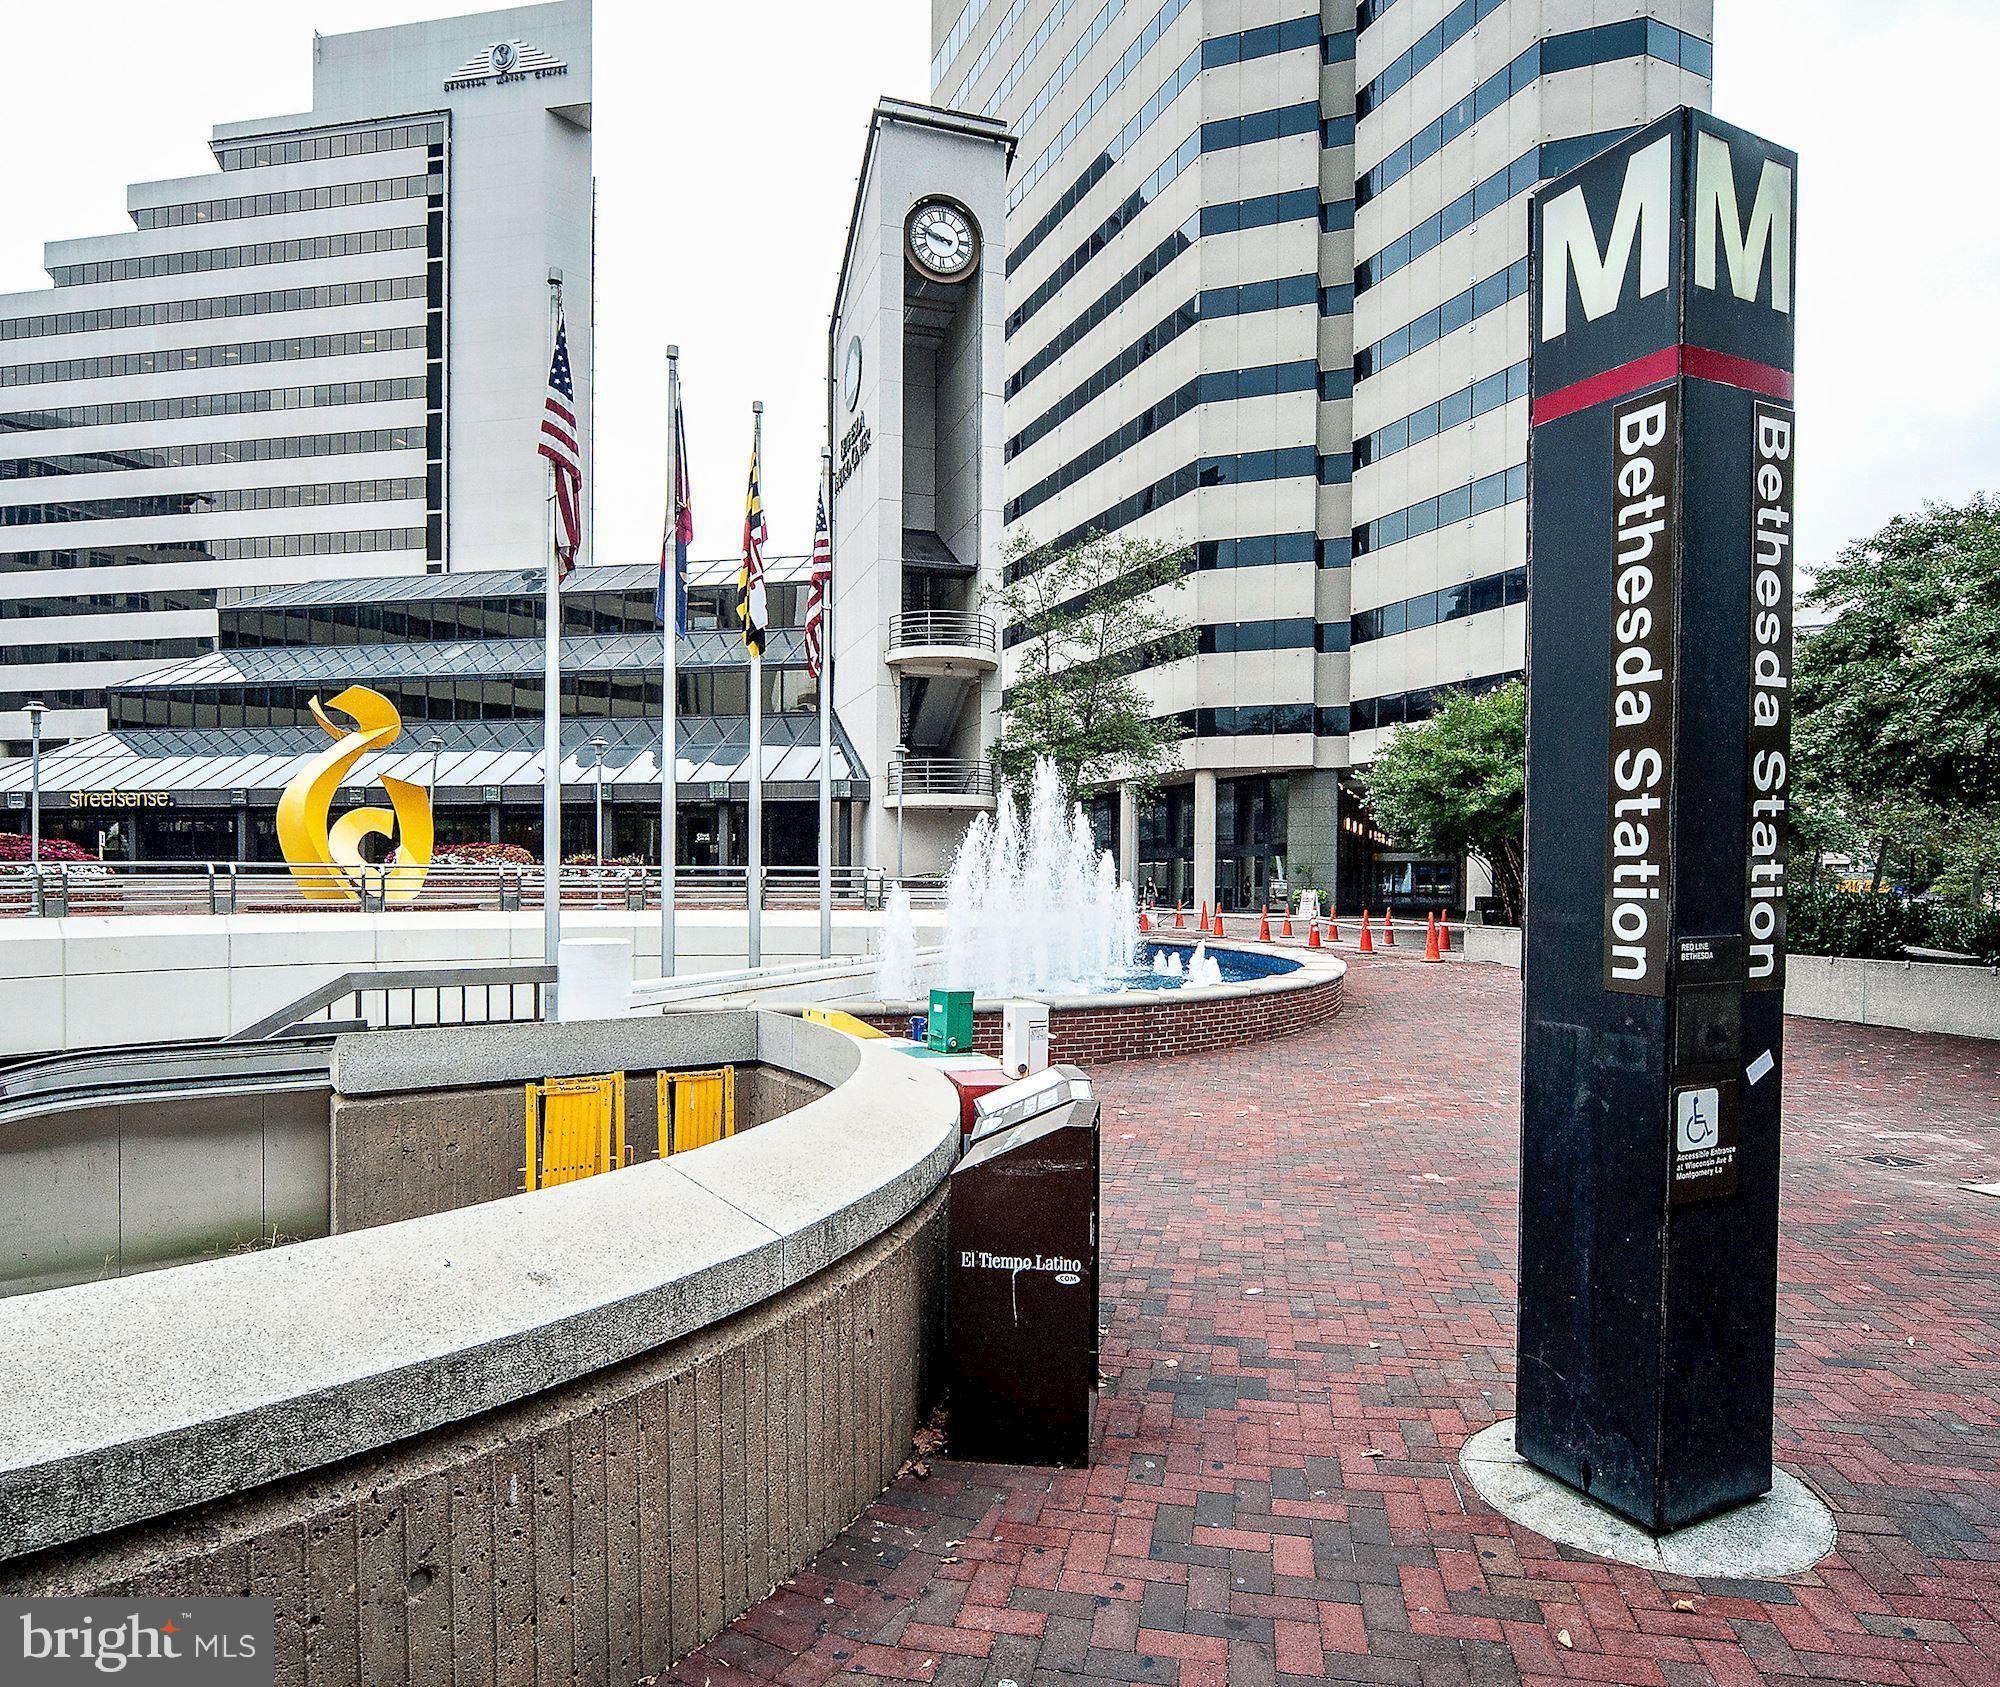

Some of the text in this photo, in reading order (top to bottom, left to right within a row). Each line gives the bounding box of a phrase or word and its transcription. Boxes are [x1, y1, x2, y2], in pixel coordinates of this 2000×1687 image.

[1694, 130, 1793, 315] M
[1542, 132, 1672, 343] M
[1611, 400, 1667, 981] Bethesda Station
[1749, 415, 1792, 978] Bethesda Station
[1681, 942, 1709, 952] RED LINE
[1681, 952, 1714, 961] BETHESDA
[1676, 1146, 1737, 1162] Accessible Entrance
[1676, 1163, 1684, 1171] at
[1684, 1158, 1715, 1170] Wisconsin
[1715, 1156, 1727, 1165] Ave
[1675, 1166, 1723, 1180] Montgomery La
[961, 1251, 1082, 1272] El Tiempo Latino
